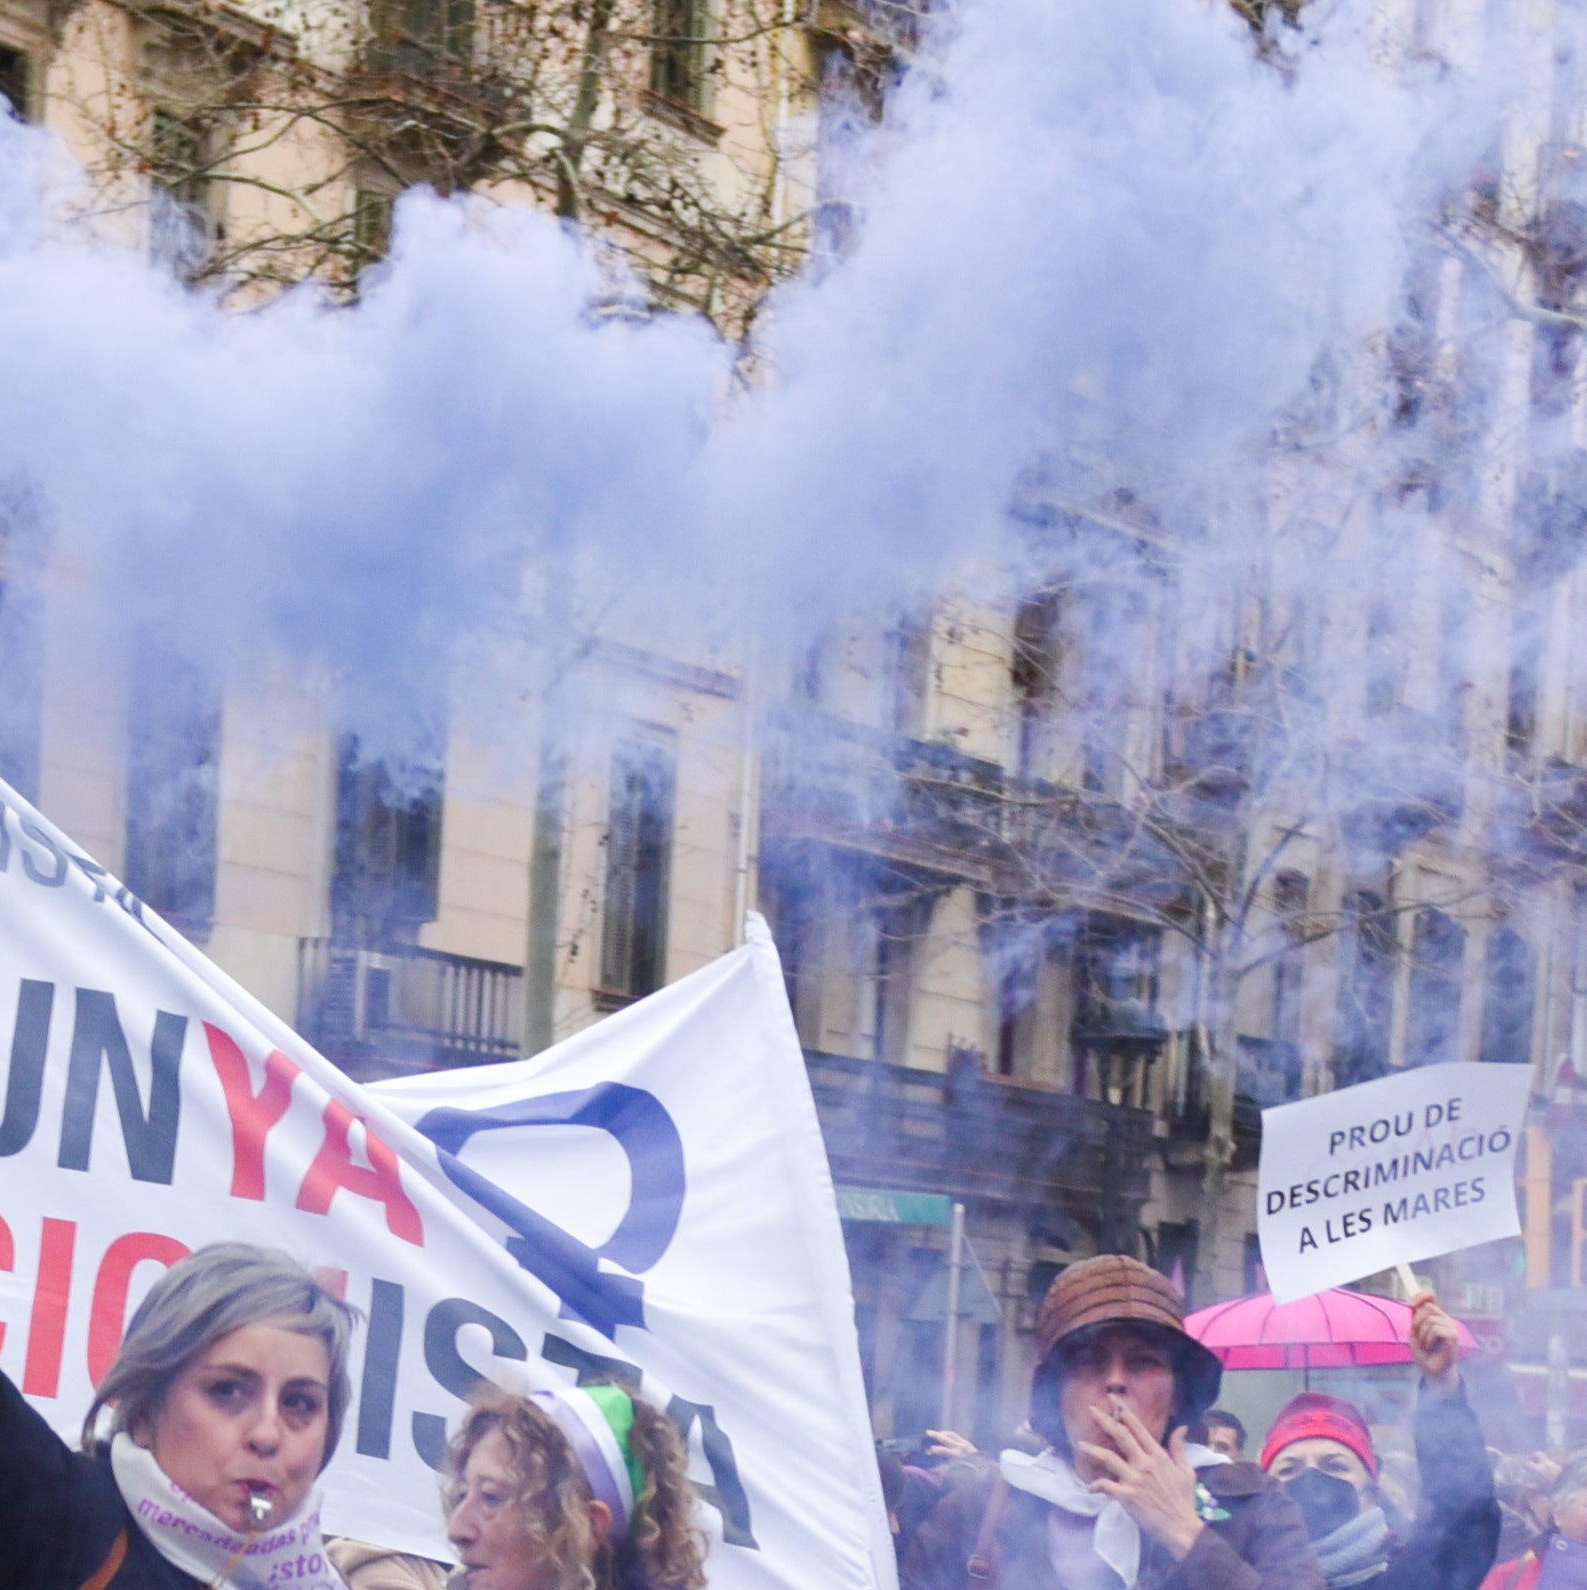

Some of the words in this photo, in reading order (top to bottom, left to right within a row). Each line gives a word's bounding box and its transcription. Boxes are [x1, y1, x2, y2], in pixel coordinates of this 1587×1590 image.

[1329, 1111, 1414, 1156] PROU
[1425, 1097, 1462, 1128] DE
[1266, 1125, 1511, 1216] DESCRIMINACIÓ
[1299, 1226, 1318, 1254] A
[1326, 1208, 1372, 1243] LES
[1383, 1177, 1486, 1225] MARES
